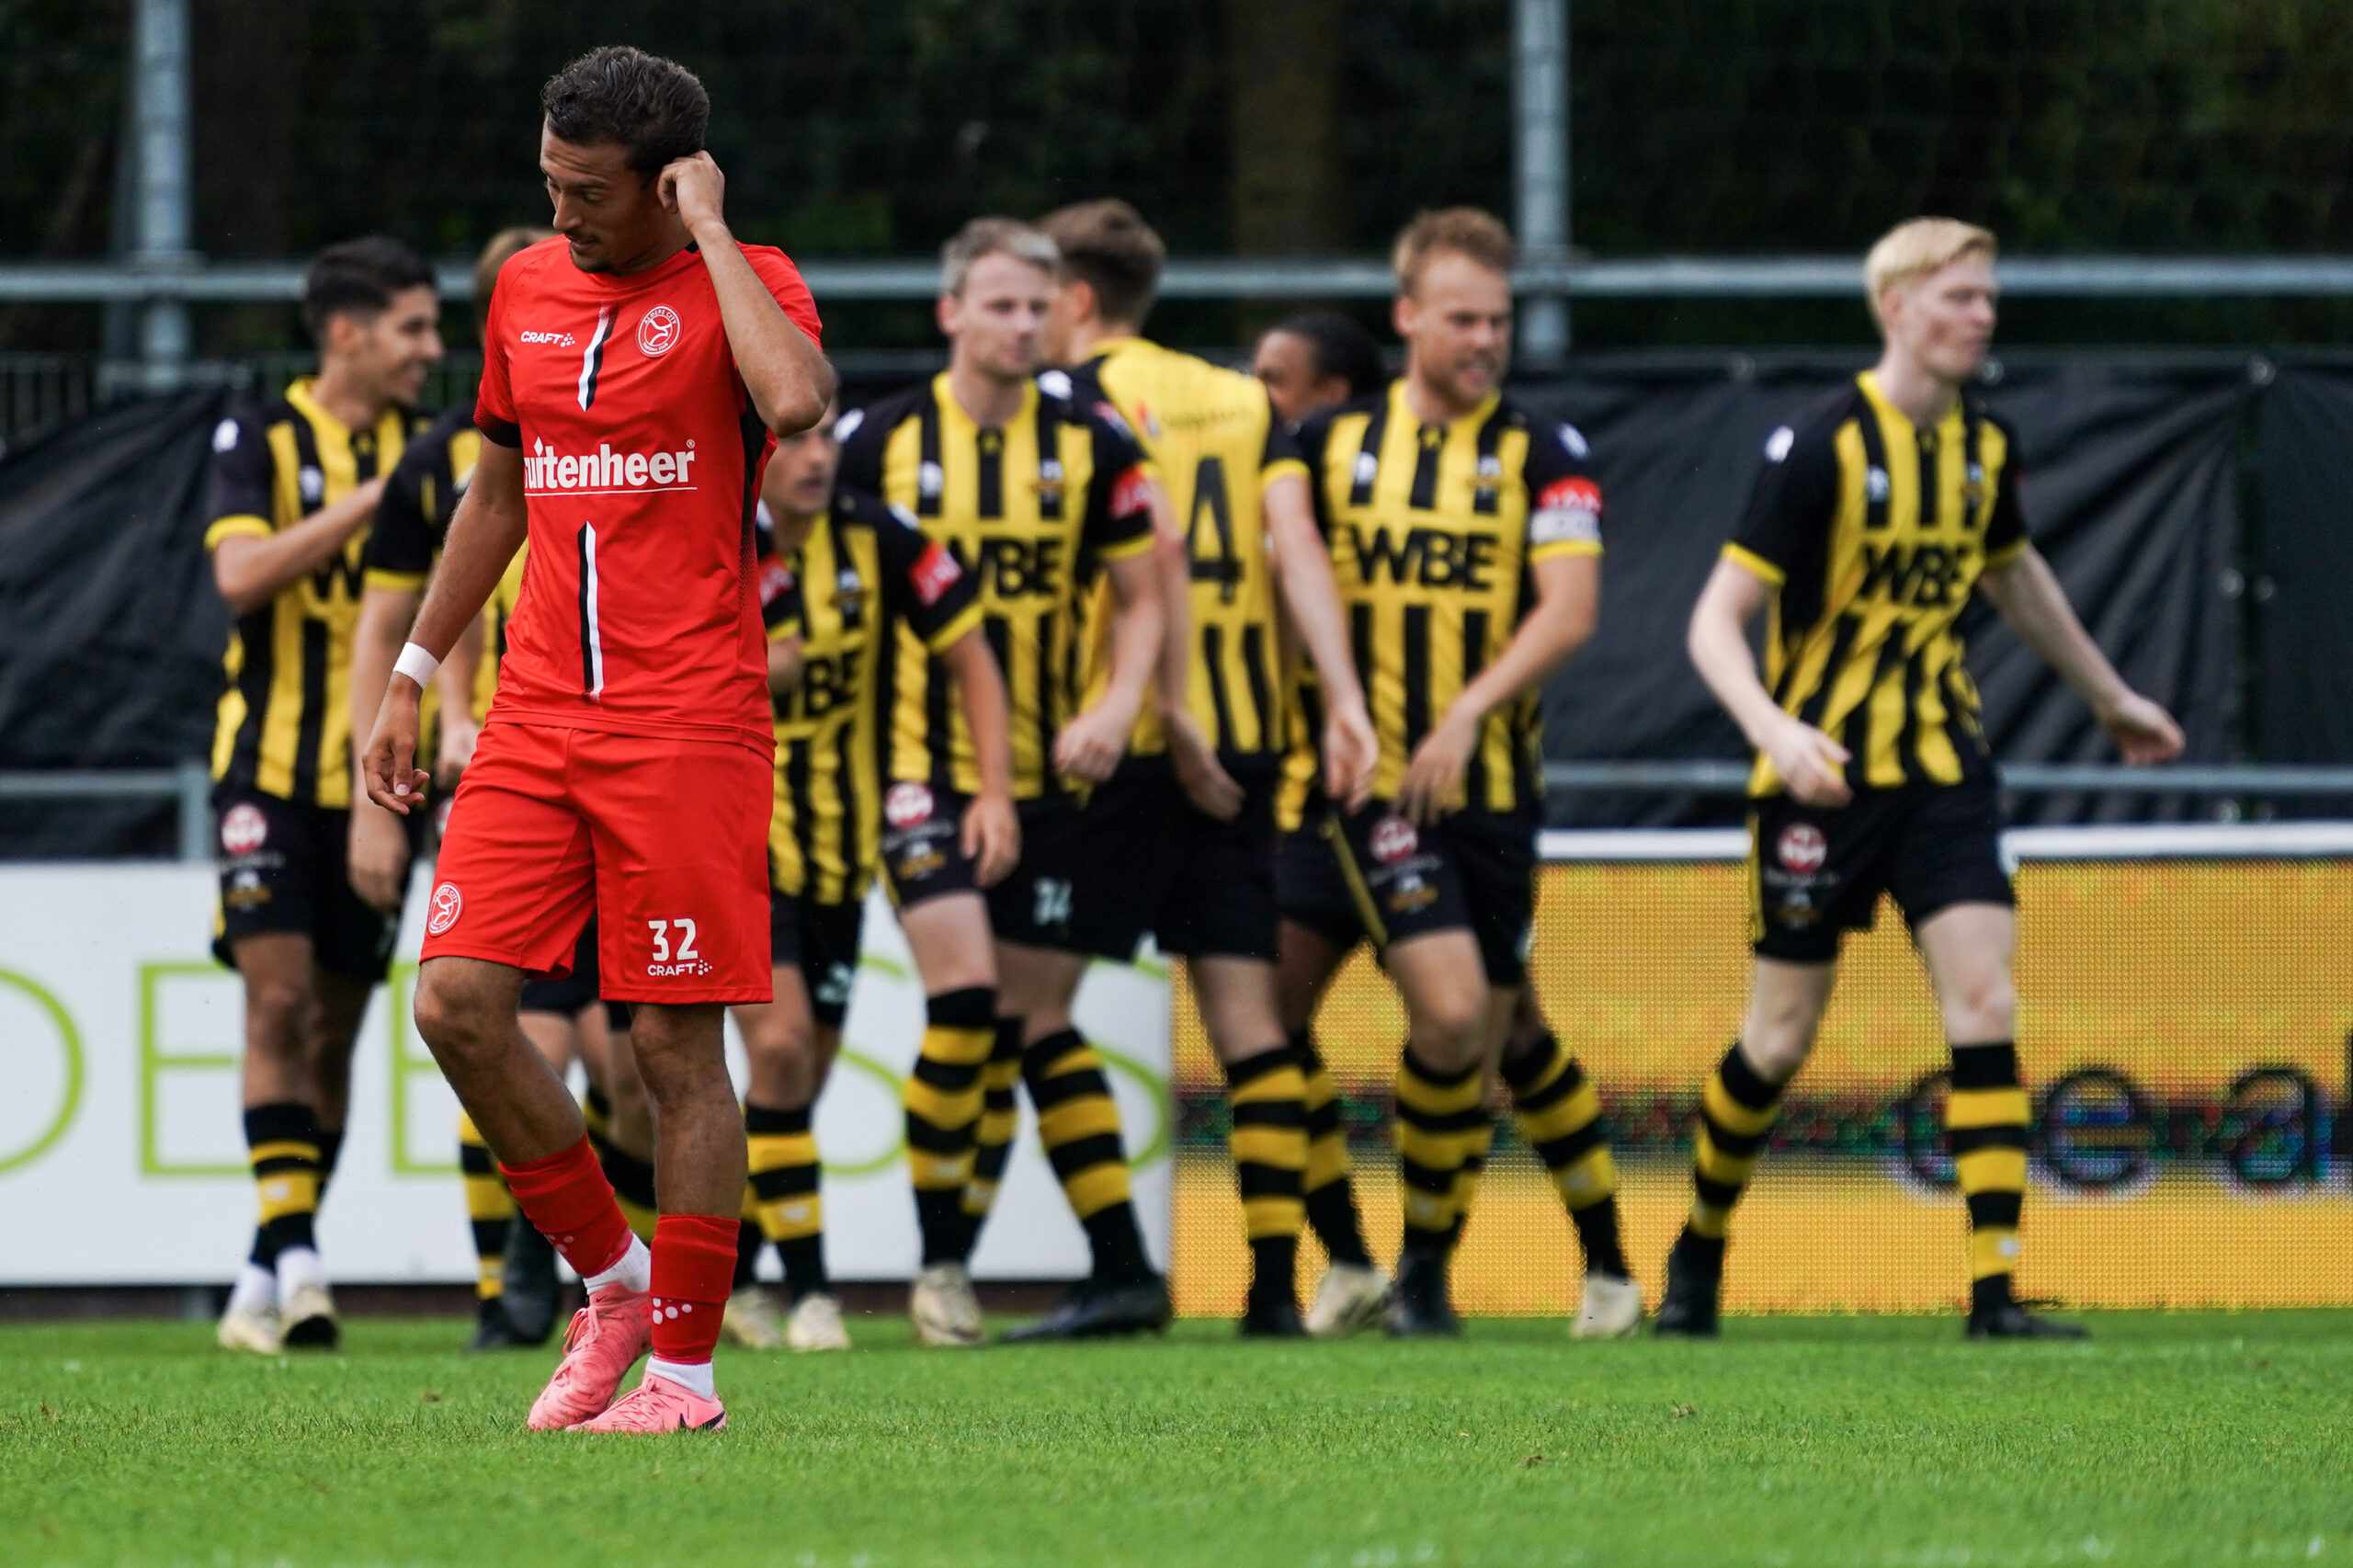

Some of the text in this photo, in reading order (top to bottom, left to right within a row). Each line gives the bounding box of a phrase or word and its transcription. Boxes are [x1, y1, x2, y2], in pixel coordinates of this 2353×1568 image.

[520, 331, 563, 345] CRAFT
[1185, 456, 1245, 607] 4
[1347, 525, 1499, 590] WBE
[648, 917, 699, 962] 32
[647, 962, 697, 976] CRAFT
